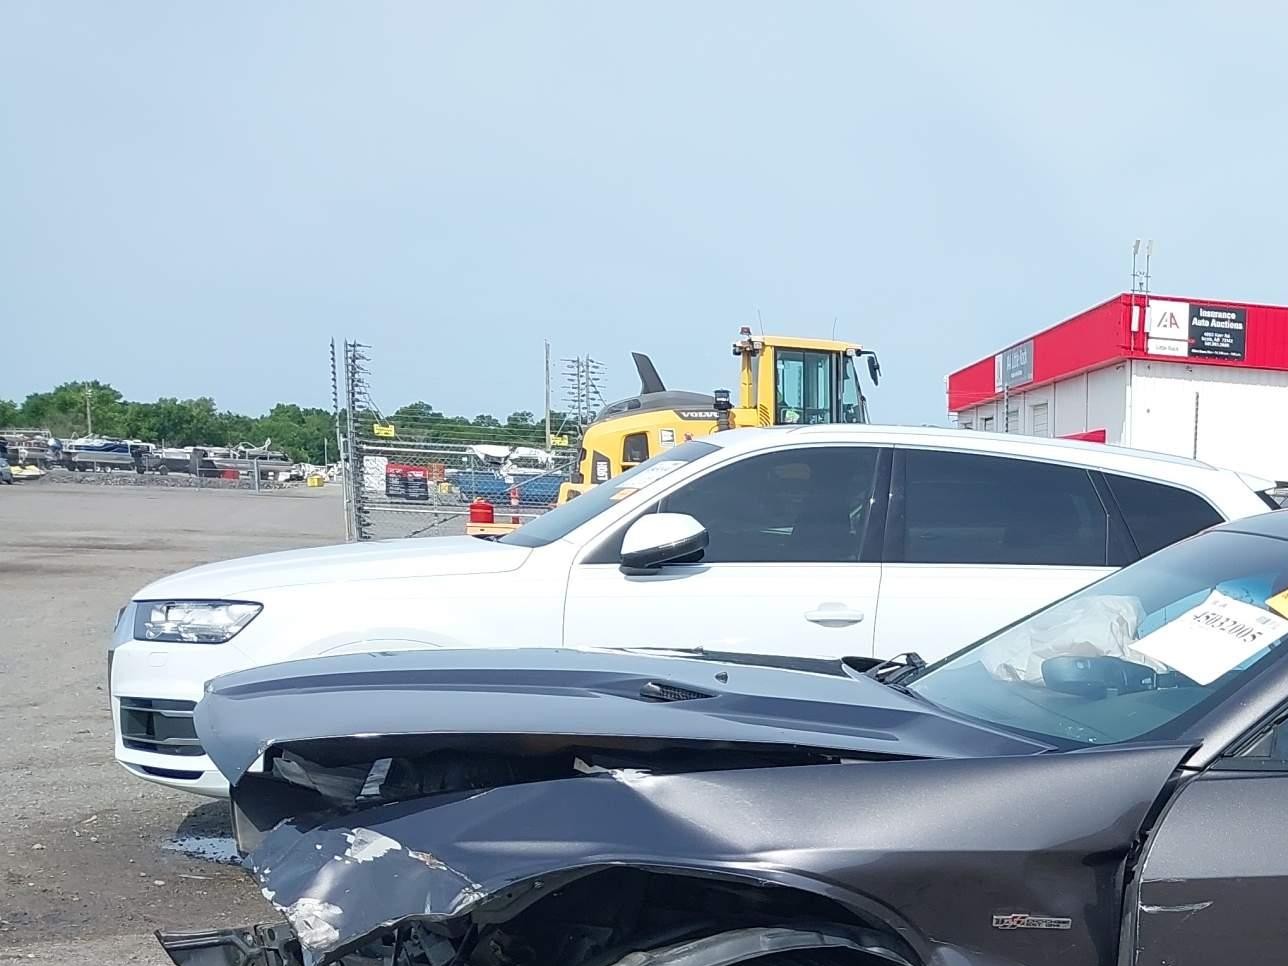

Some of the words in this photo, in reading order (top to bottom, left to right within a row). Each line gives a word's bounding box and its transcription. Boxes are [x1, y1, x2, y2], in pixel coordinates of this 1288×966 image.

[1200, 308, 1236, 320] Insurance
[1192, 317, 1210, 327] Auto
[1210, 319, 1243, 330] Auctions
[1192, 611, 1264, 642] 45032005
